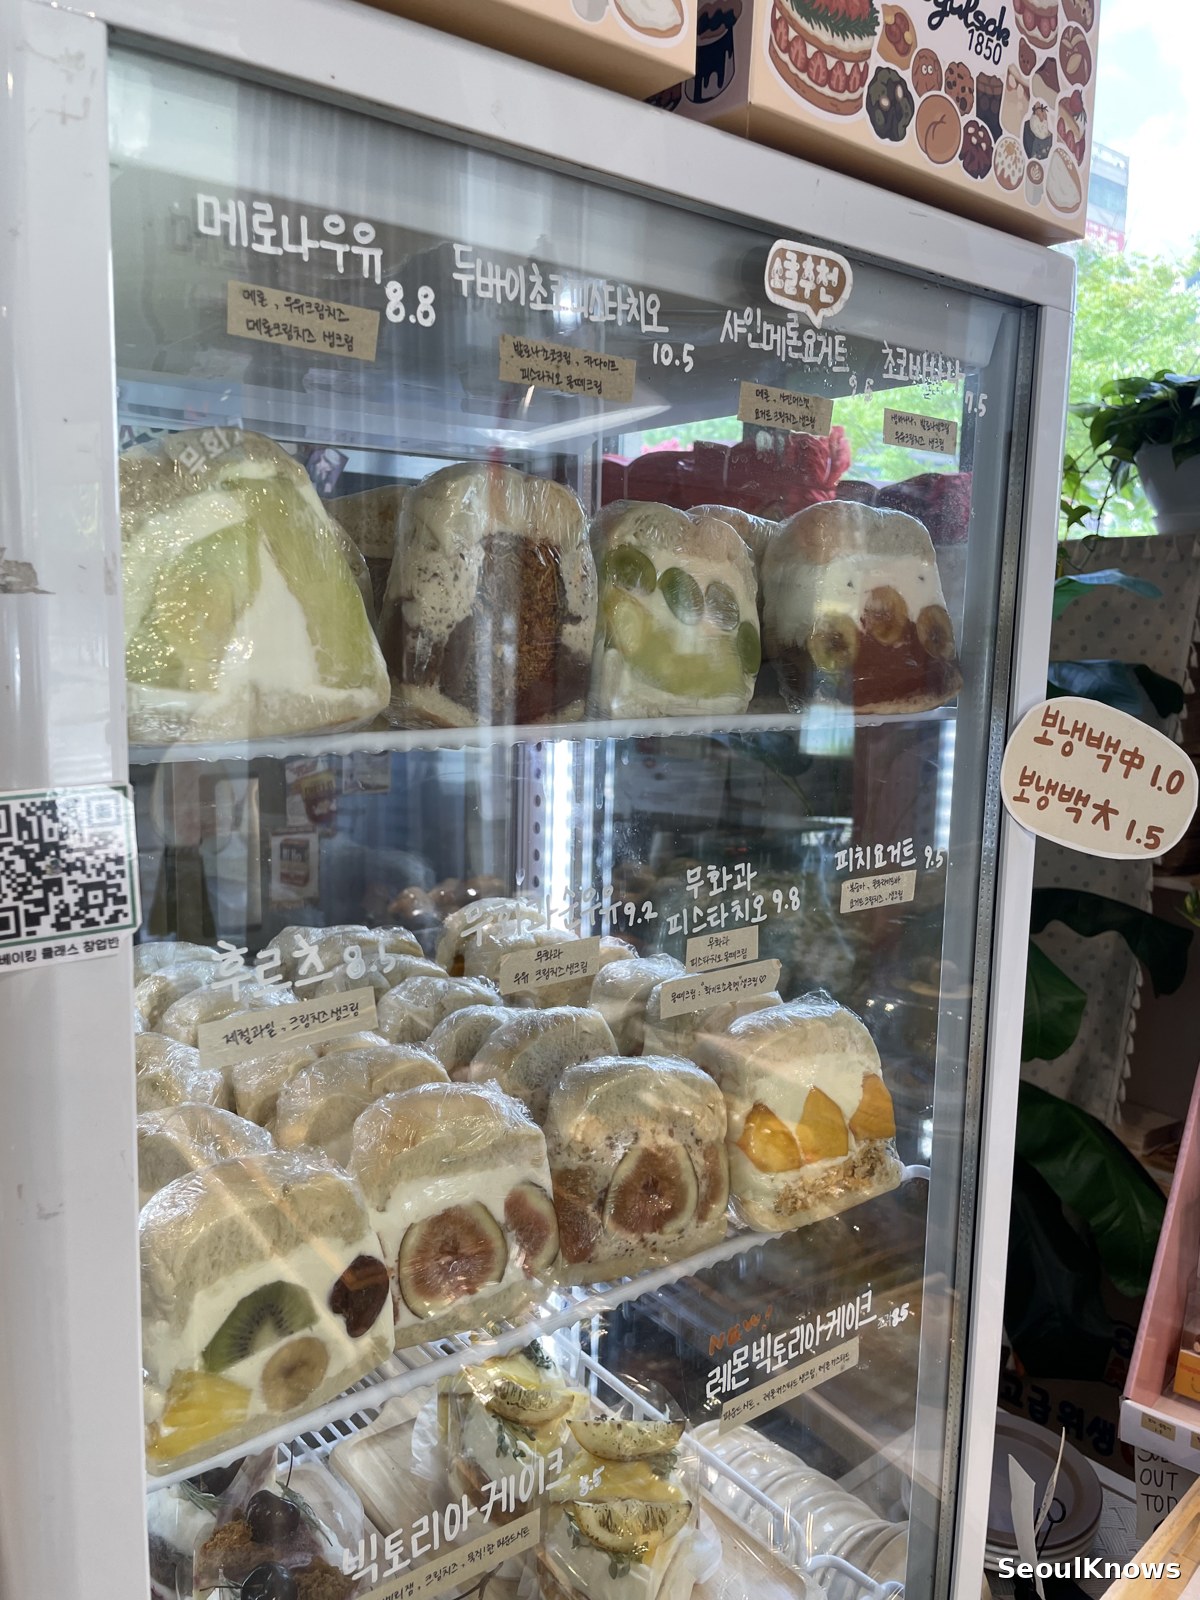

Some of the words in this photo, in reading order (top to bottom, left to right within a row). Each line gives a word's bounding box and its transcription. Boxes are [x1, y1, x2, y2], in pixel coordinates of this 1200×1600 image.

[968, 29, 1002, 65] 1850
[196, 193, 383, 285] 메로나우유
[385, 280, 436, 327] 8.8
[720, 306, 850, 373] 샤인메론요거트
[583, 355, 619, 372] 카다이프
[652, 342, 695, 373] 10.5
[965, 390, 988, 418] 7.5
[1150, 764, 1185, 795] 1.0
[1125, 819, 1165, 850] 1.5
[834, 837, 917, 872] 피치요거트
[924, 845, 944, 869] 9.5
[685, 862, 758, 900] 무화과
[623, 901, 659, 927] 9.2
[666, 895, 768, 935] 피스타치오
[772, 886, 801, 911] 9.8
[41, 943, 80, 960] 클래스
[82, 936, 120, 954] 창업반
[534, 949, 564, 963] 무화과
[707, 936, 730, 949] 무화과
[210, 934, 334, 1001] 후르츠
[689, 954, 722, 967] 피스타치오
[513, 971, 529, 984] 우유
[1139, 1467, 1179, 1491] OUT
[341, 1447, 571, 1584] 빅토리아케이크
[578, 1465, 605, 1497] 8.5
